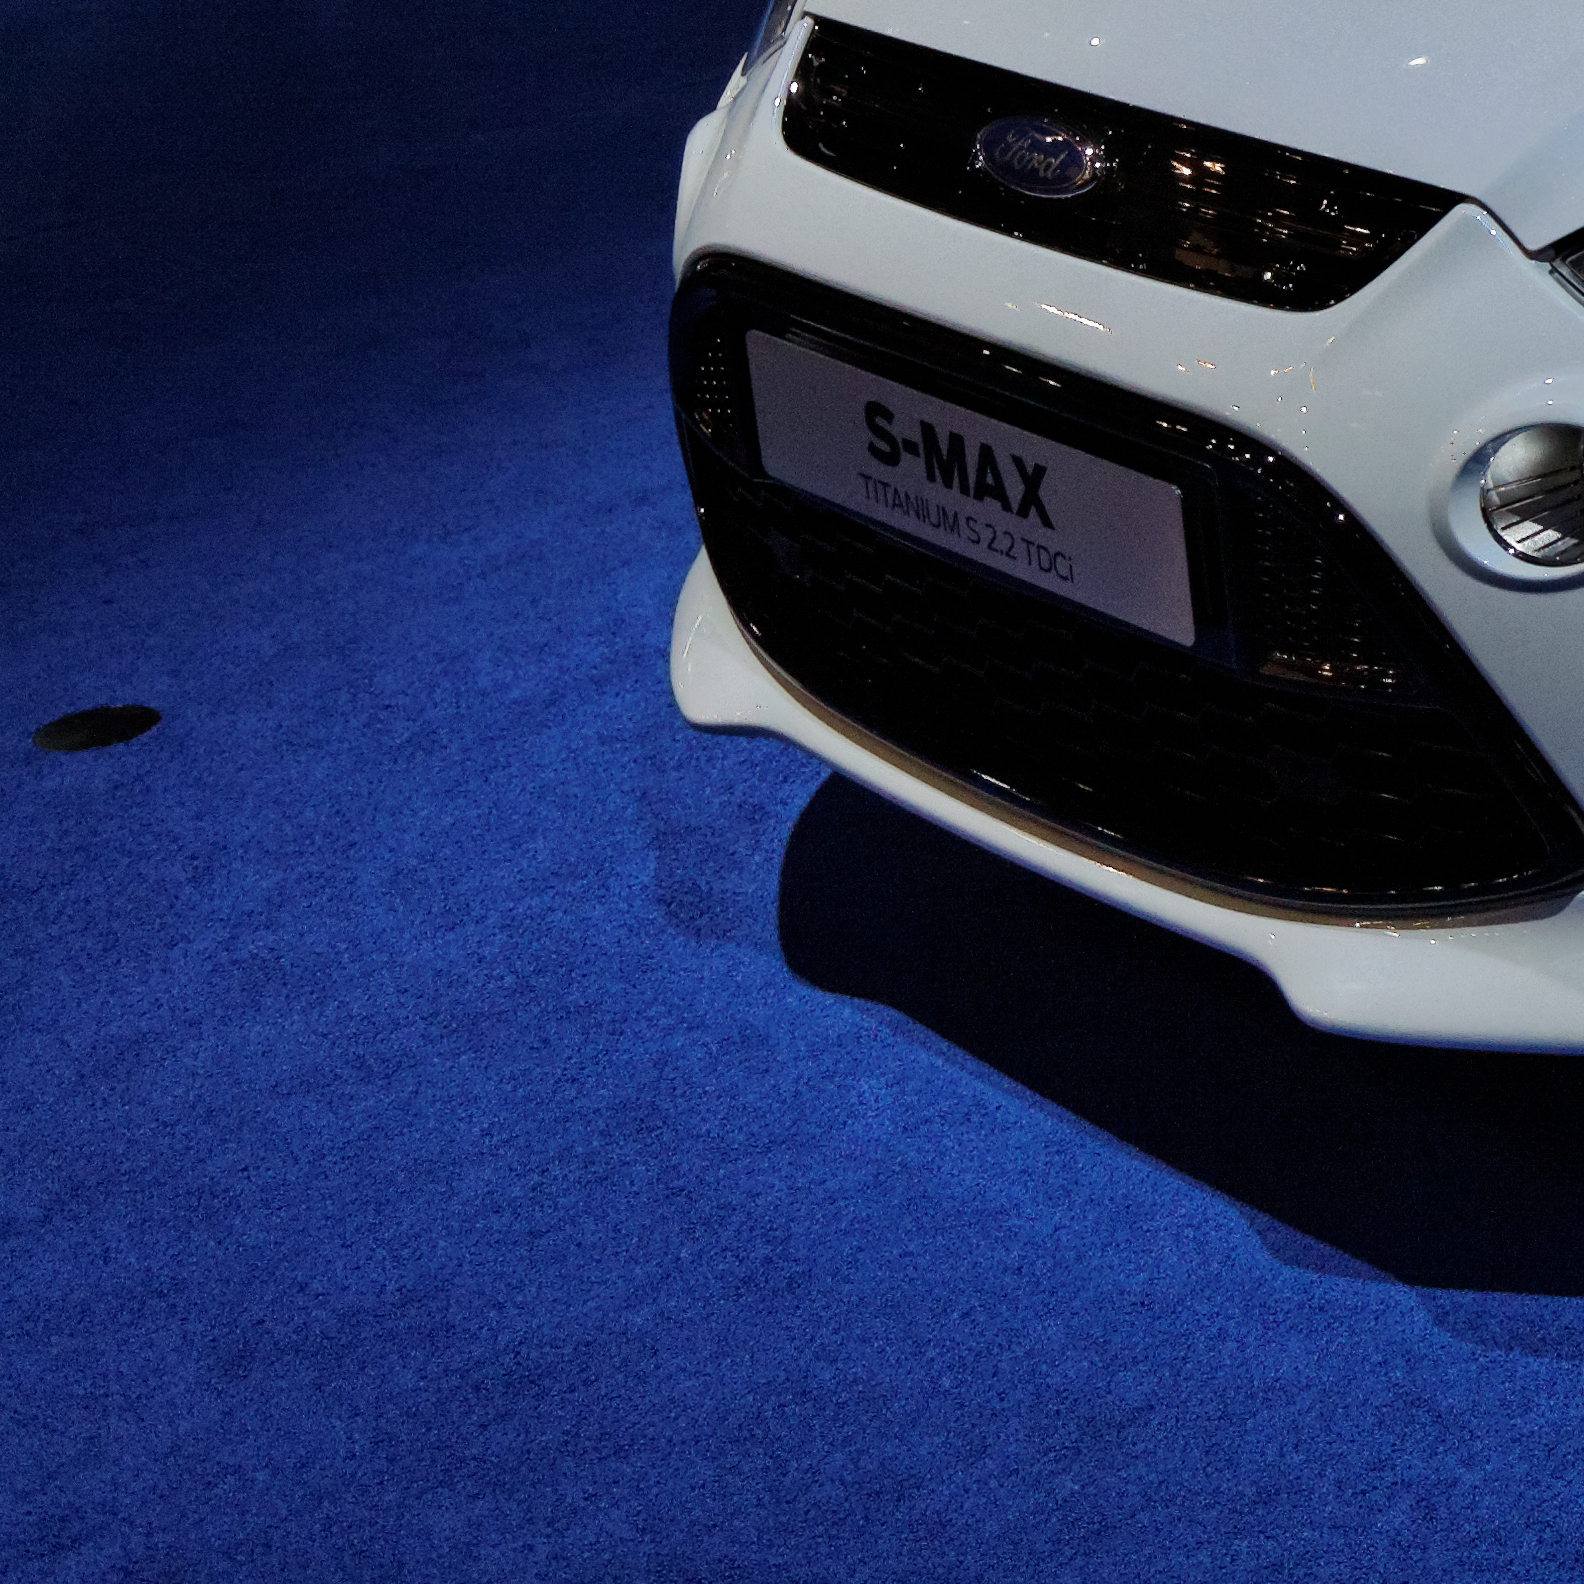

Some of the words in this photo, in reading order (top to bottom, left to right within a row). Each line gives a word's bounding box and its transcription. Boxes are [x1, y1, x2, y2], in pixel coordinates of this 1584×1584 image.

[995, 126, 1070, 180] Ford
[864, 400, 1055, 531] S-MAX
[857, 472, 962, 539] TITANIUM
[965, 516, 982, 546] S
[984, 523, 1018, 561] 2.2
[1020, 536, 1075, 584] TDCi
